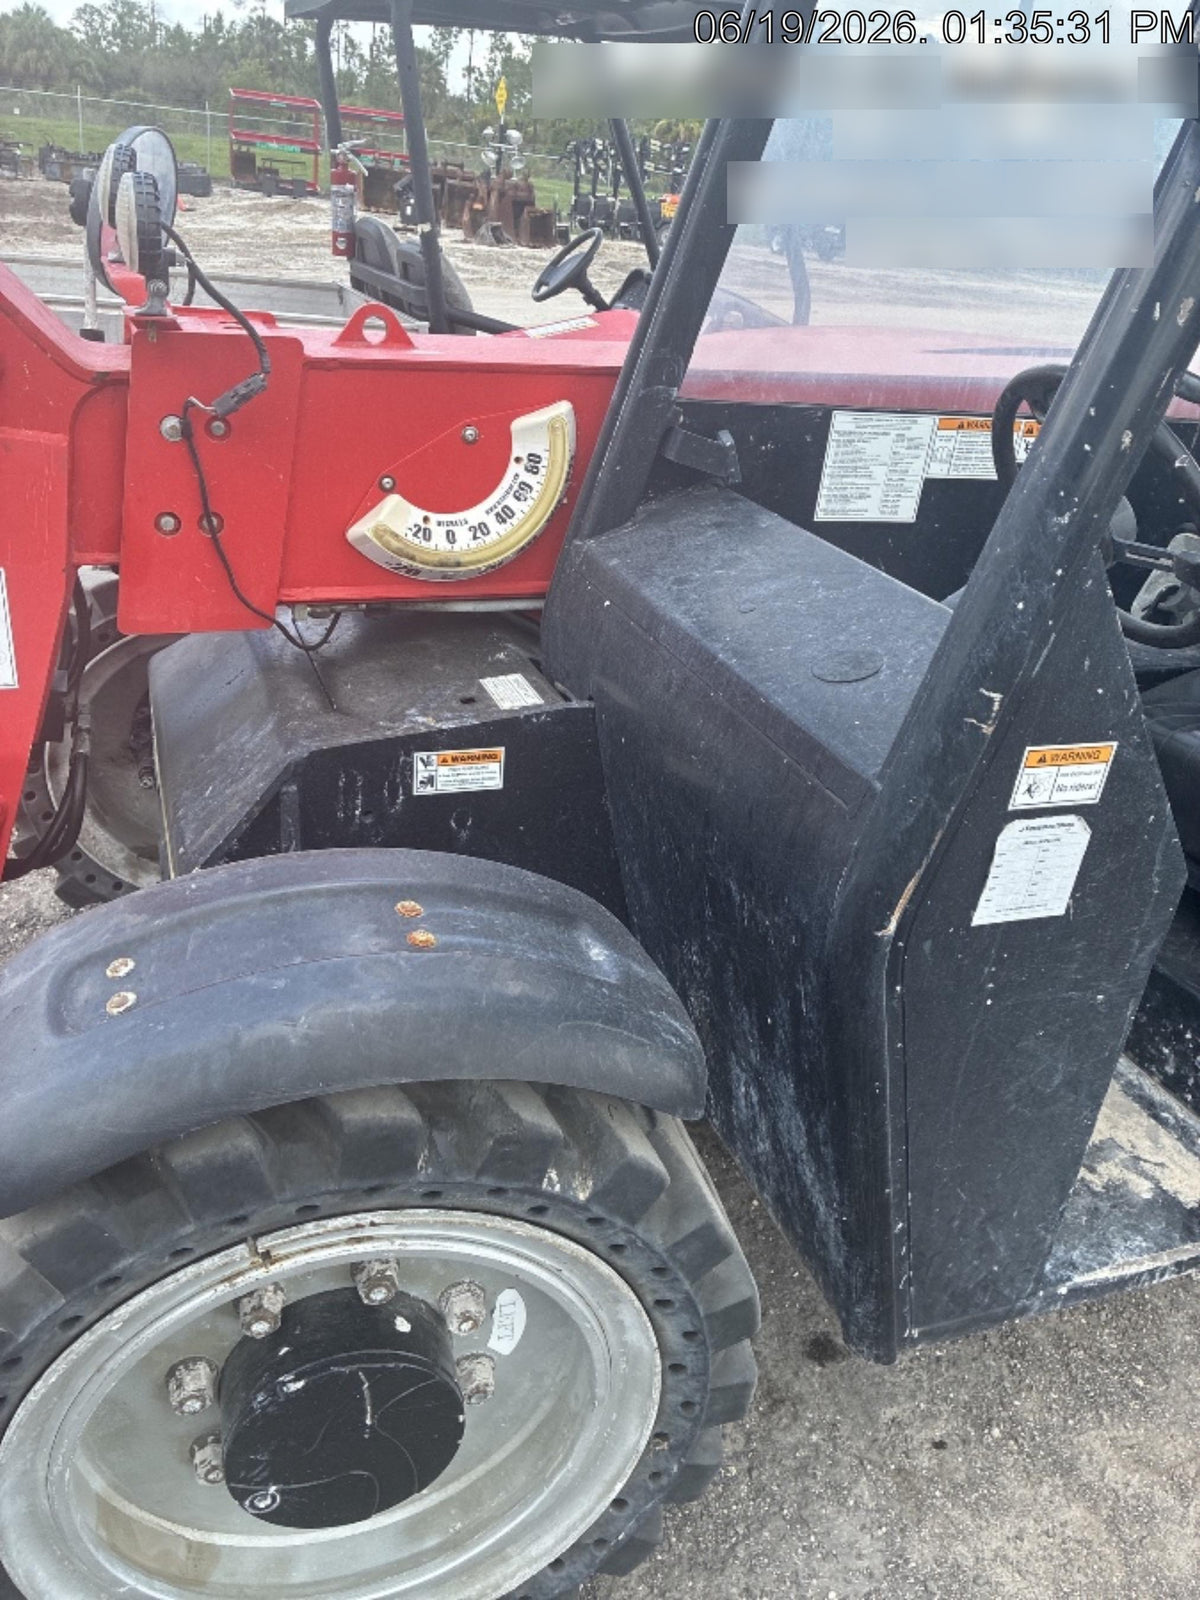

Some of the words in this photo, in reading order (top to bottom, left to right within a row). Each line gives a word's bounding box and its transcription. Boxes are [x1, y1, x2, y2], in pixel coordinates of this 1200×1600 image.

[446, 529, 457, 545] 0
[468, 521, 491, 541] 20
[494, 504, 516, 525] 40
[524, 453, 542, 475] 80
[450, 753, 498, 763] WARNING
[1050, 749, 1102, 762] WARNING
